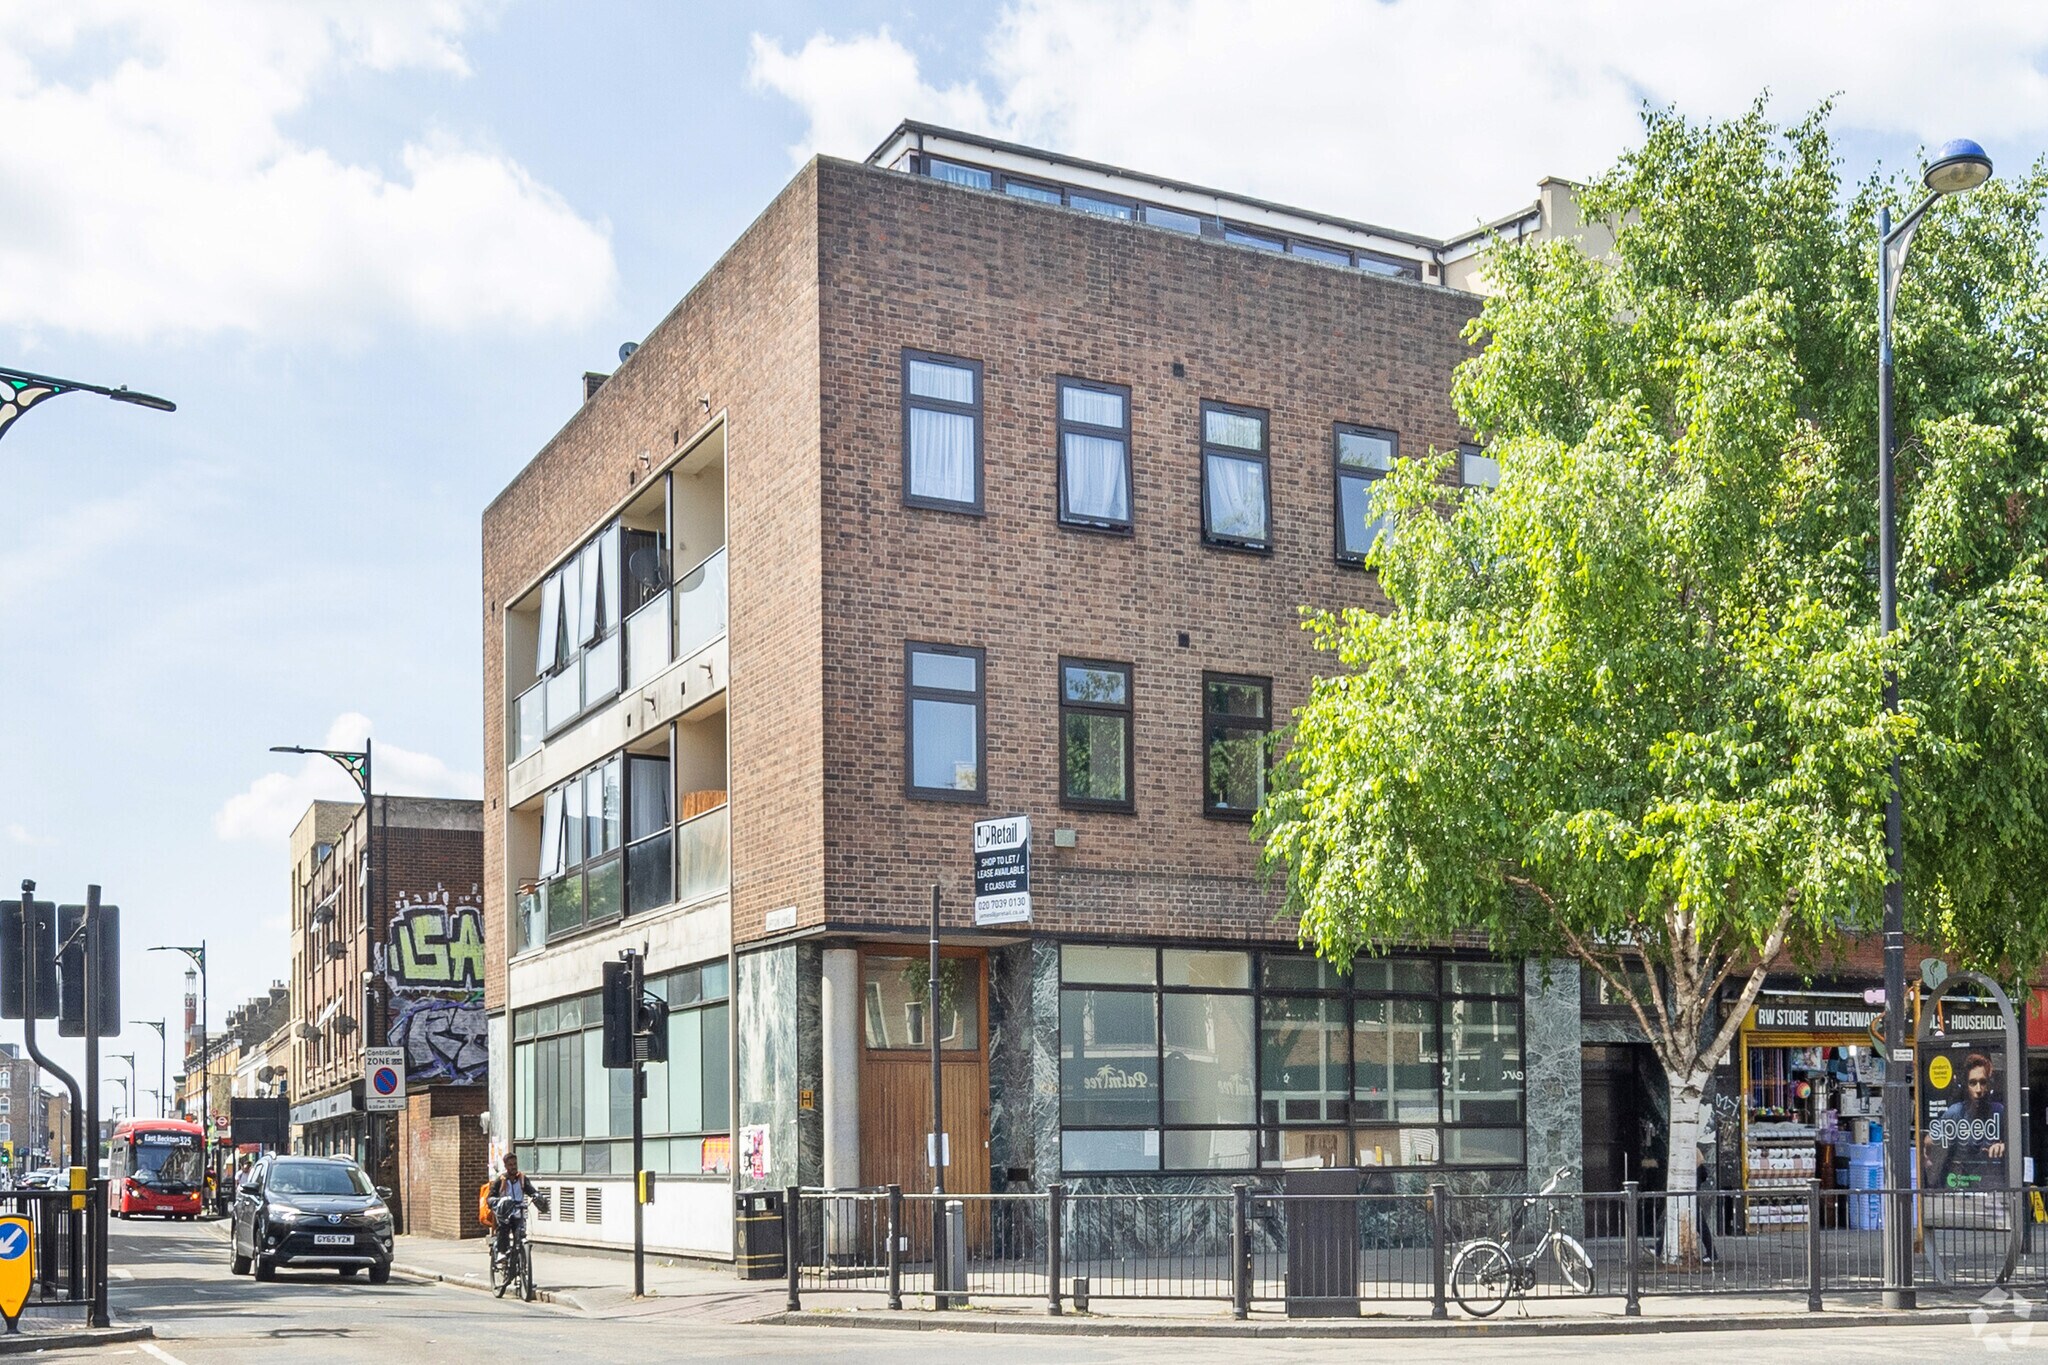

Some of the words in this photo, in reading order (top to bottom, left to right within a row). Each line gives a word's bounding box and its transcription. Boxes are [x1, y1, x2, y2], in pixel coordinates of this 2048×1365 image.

[991, 823, 1017, 845] Retail
[981, 857, 996, 867] SHOP
[997, 856, 1005, 865] TO
[977, 869, 993, 879] LEASE
[994, 865, 1025, 877] AVAILABLE
[989, 881, 1005, 890] CLASS
[1006, 880, 1016, 889] USE
[978, 901, 990, 910] 020
[991, 898, 1007, 909] 7039
[1008, 897, 1025, 907] 0130
[1758, 1009, 1775, 1025] RW
[1776, 1009, 1808, 1026] STORE
[1929, 1113, 2000, 1148] speed
[144, 1134, 156, 1142] East
[179, 1136, 192, 1146] 325
